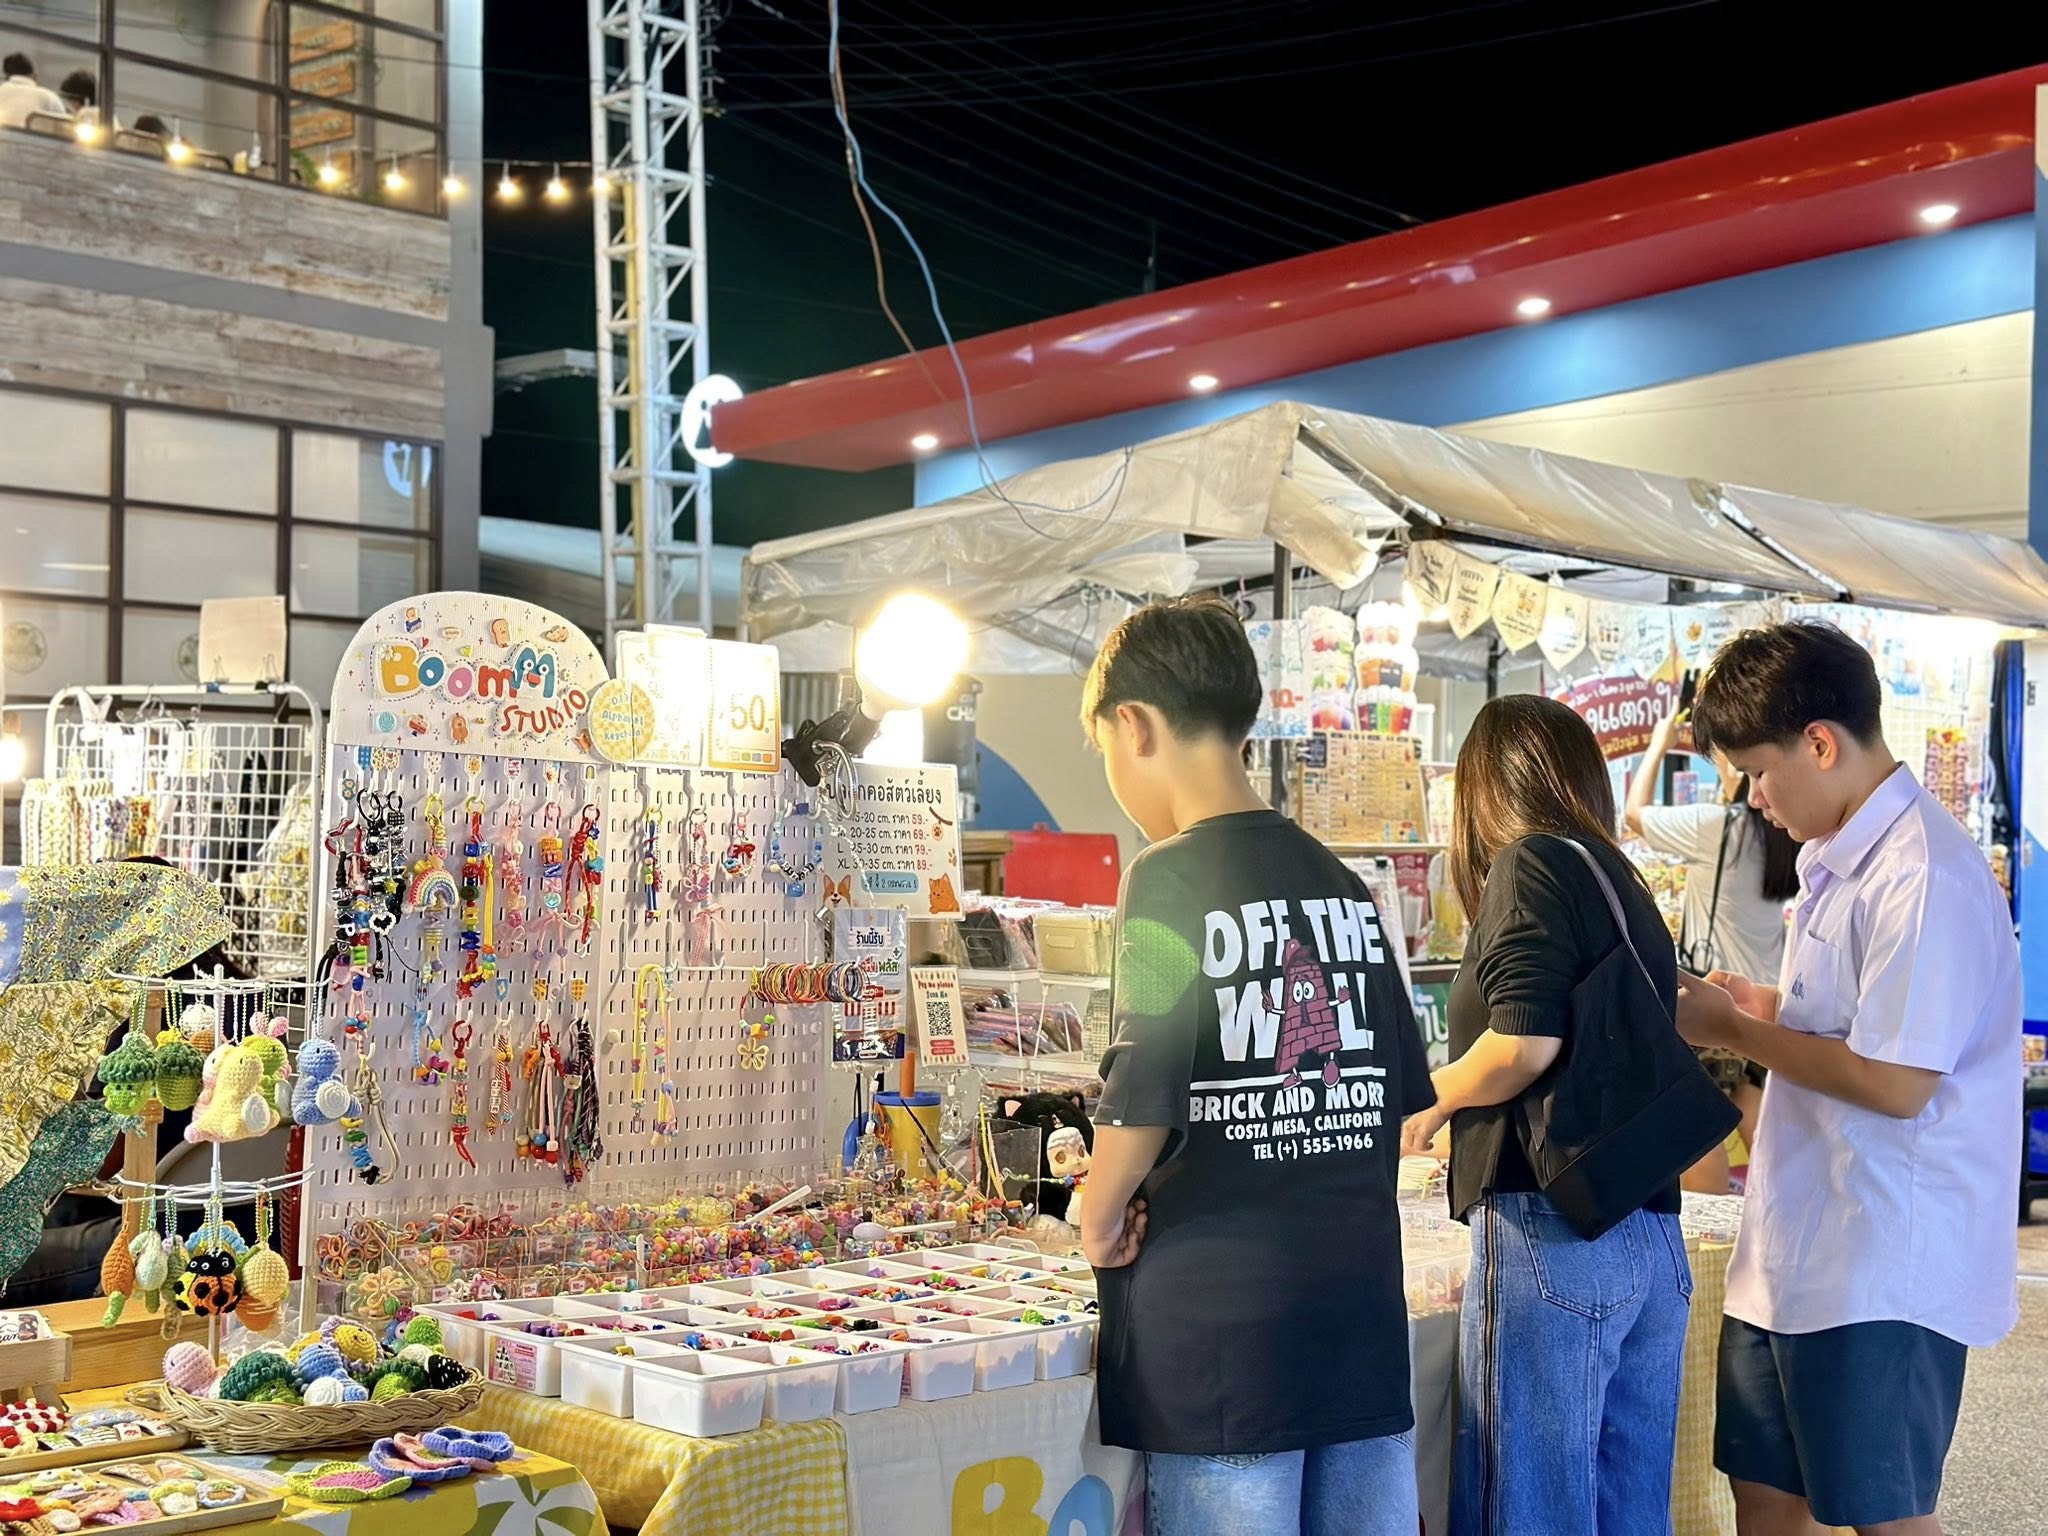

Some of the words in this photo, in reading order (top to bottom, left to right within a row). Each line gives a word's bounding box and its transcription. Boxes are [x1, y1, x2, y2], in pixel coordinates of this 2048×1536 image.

[501, 689, 587, 734] STUDIO
[877, 814, 890, 822] cm.
[892, 813, 910, 824] ราคา
[850, 826, 877, 838] 20-25
[878, 830, 891, 839] cm.
[893, 828, 911, 840] ราคา
[837, 843, 844, 854] L
[880, 845, 893, 855] cm.
[895, 844, 913, 855] ราคา
[837, 858, 850, 869] XL
[882, 861, 896, 871] cm.
[897, 860, 915, 871] ราคา
[1202, 900, 1291, 979] OFF
[1300, 897, 1385, 965] THE
[1189, 1090, 1266, 1123] BRICK
[1272, 1086, 1316, 1117] AND
[1225, 1122, 1268, 1141] COSTA
[1272, 1118, 1312, 1137] MESA,
[1253, 1143, 1274, 1161] TEL
[1277, 1140, 1298, 1162] (+)
[1303, 1132, 1374, 1156] 555-1966
[951, 1455, 1145, 1536] BO
